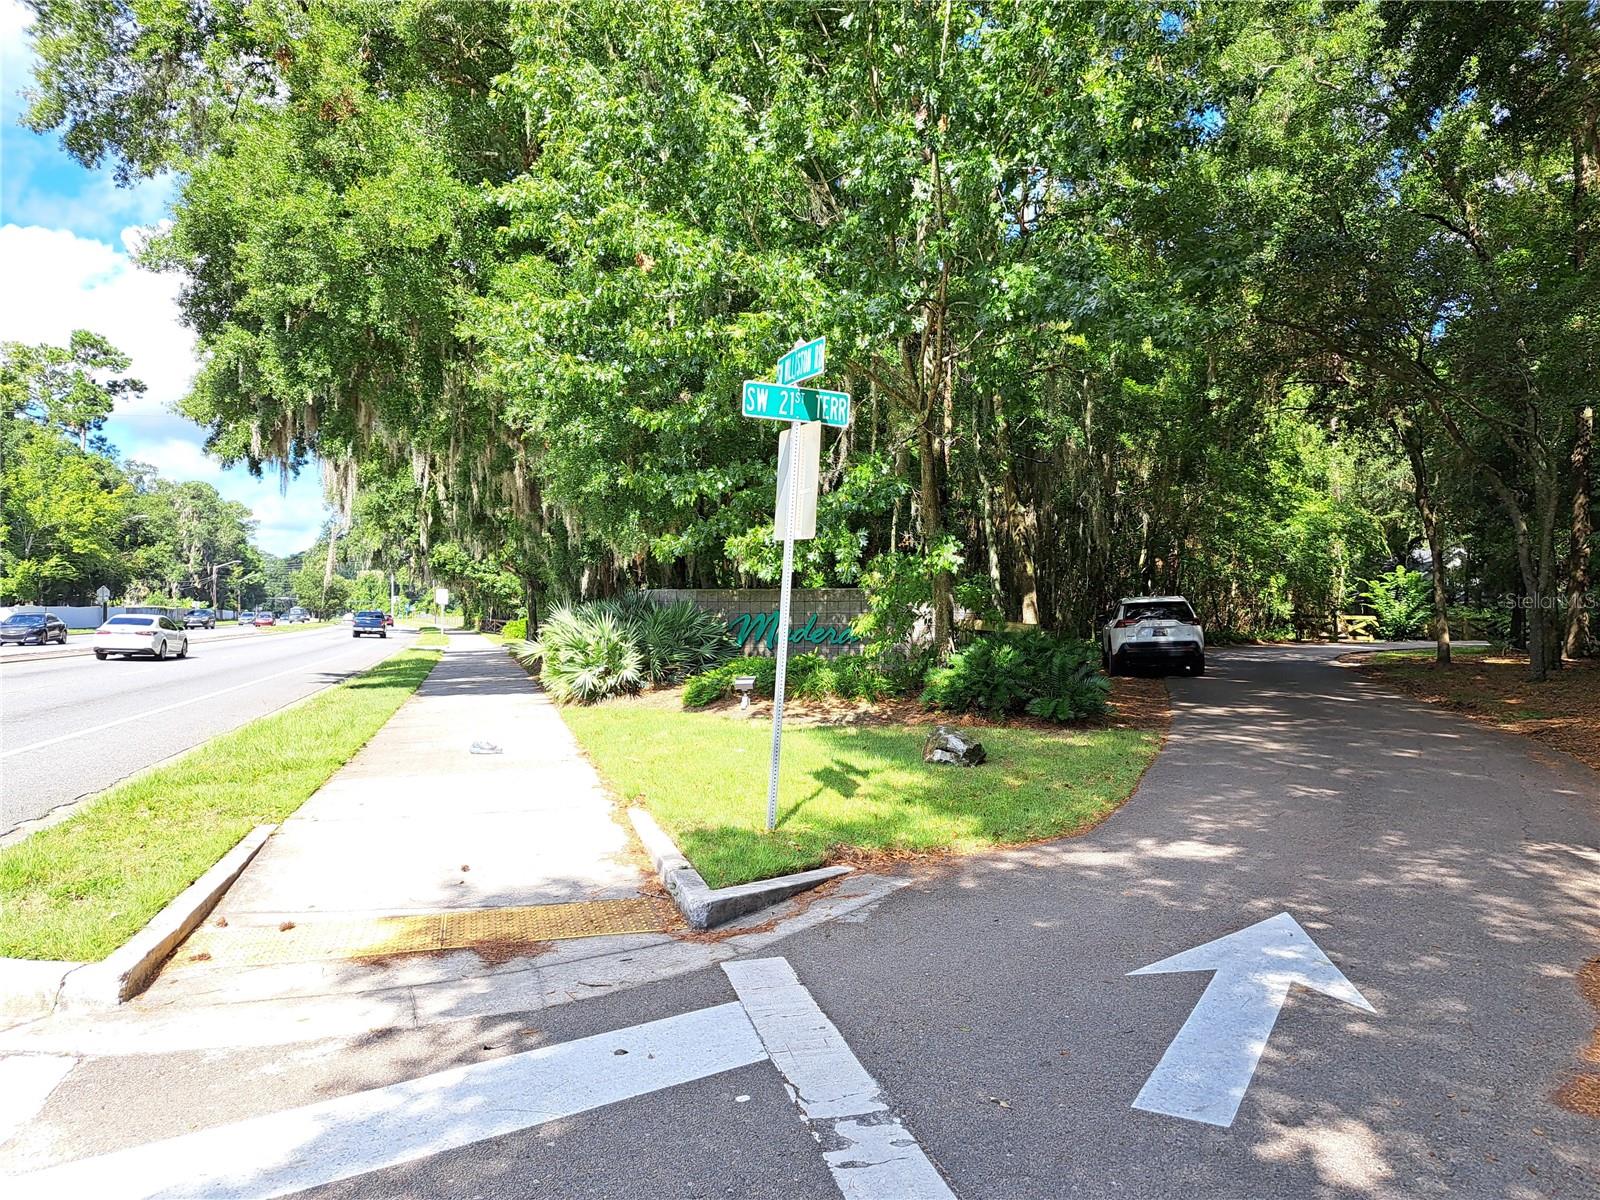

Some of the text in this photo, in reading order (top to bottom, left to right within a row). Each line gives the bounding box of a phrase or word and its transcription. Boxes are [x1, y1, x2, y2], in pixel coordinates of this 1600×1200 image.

[746, 386, 769, 413] SW
[815, 394, 847, 420] TERR
[728, 610, 860, 650] Mdera
